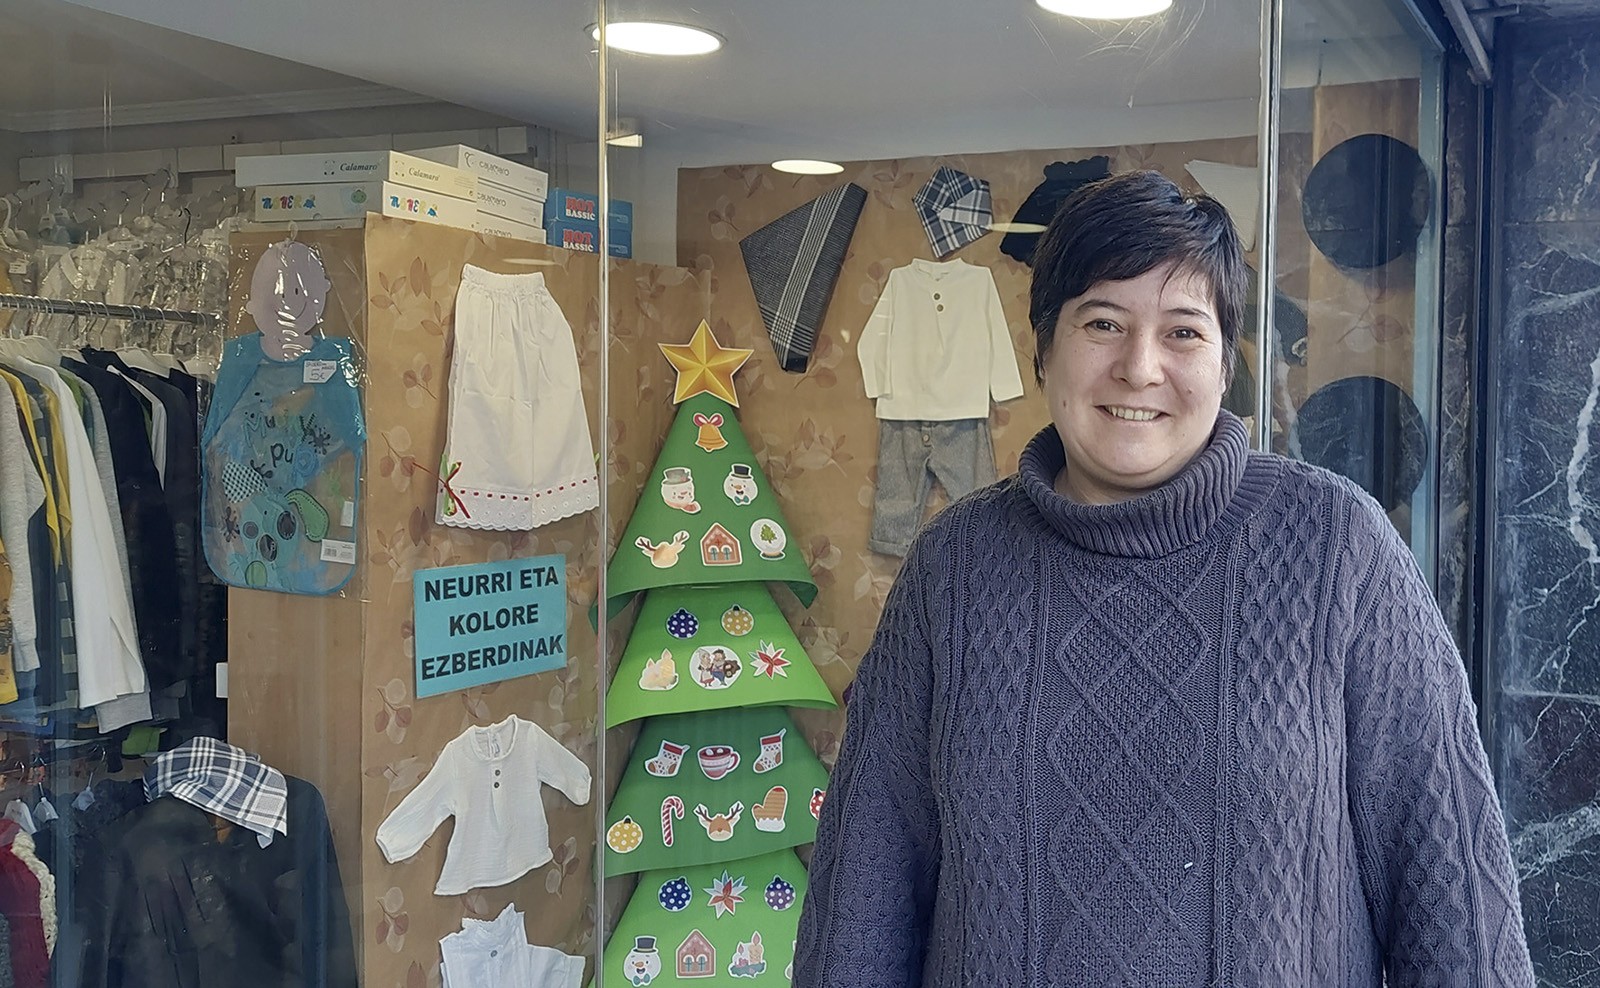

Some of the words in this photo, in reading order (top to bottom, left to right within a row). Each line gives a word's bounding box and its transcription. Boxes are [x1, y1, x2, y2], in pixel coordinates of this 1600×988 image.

[339, 162, 378, 172] Calamaro
[408, 166, 440, 182] Calamaro
[565, 195, 595, 214] HOT
[565, 207, 596, 221] BASSIC
[562, 227, 594, 245] HOT
[563, 240, 594, 252] BASSIC
[424, 571, 512, 602] NEURRI
[520, 566, 559, 589] ETA
[449, 603, 539, 637] KOLORE
[421, 634, 564, 681] EZBERDINAK
